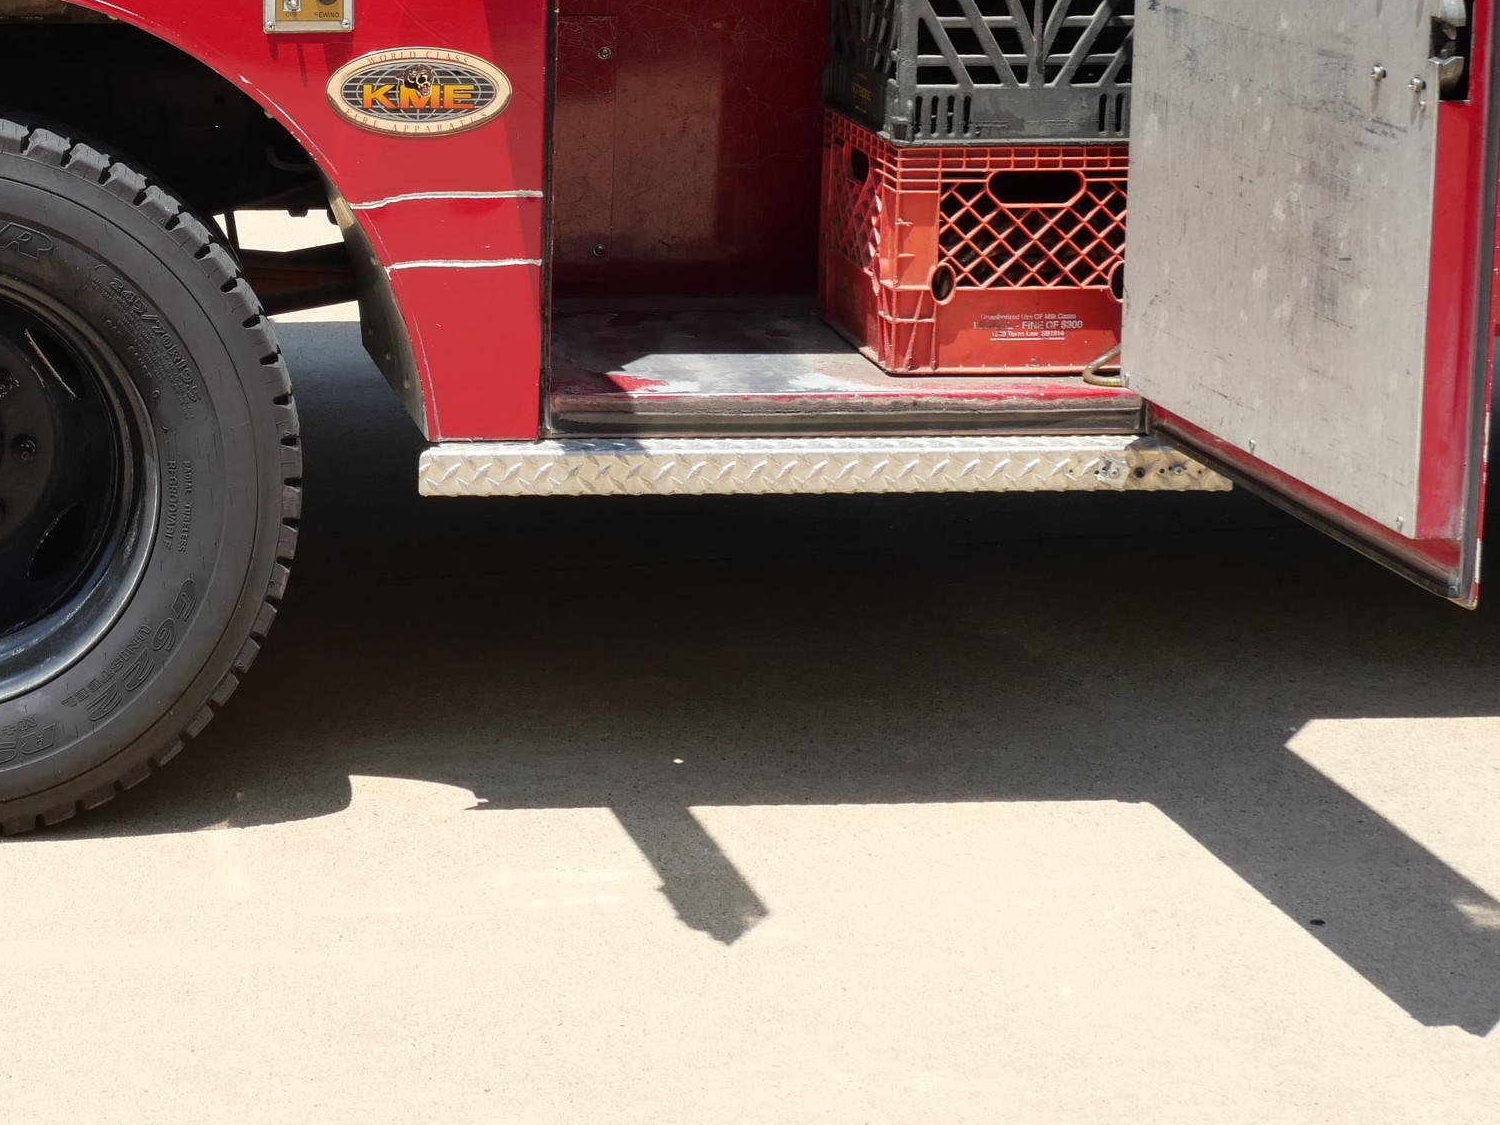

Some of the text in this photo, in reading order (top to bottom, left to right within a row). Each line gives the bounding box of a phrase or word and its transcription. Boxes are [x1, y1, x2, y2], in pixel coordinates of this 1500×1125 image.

[366, 51, 470, 65] WORLD CLASS
[361, 84, 476, 110] KME
[345, 107, 488, 134] FIRE APPARATUS
[1021, 320, 1044, 330] FINE
[1045, 320, 1060, 329] OF
[60, 623, 151, 708] UNISTEEL
